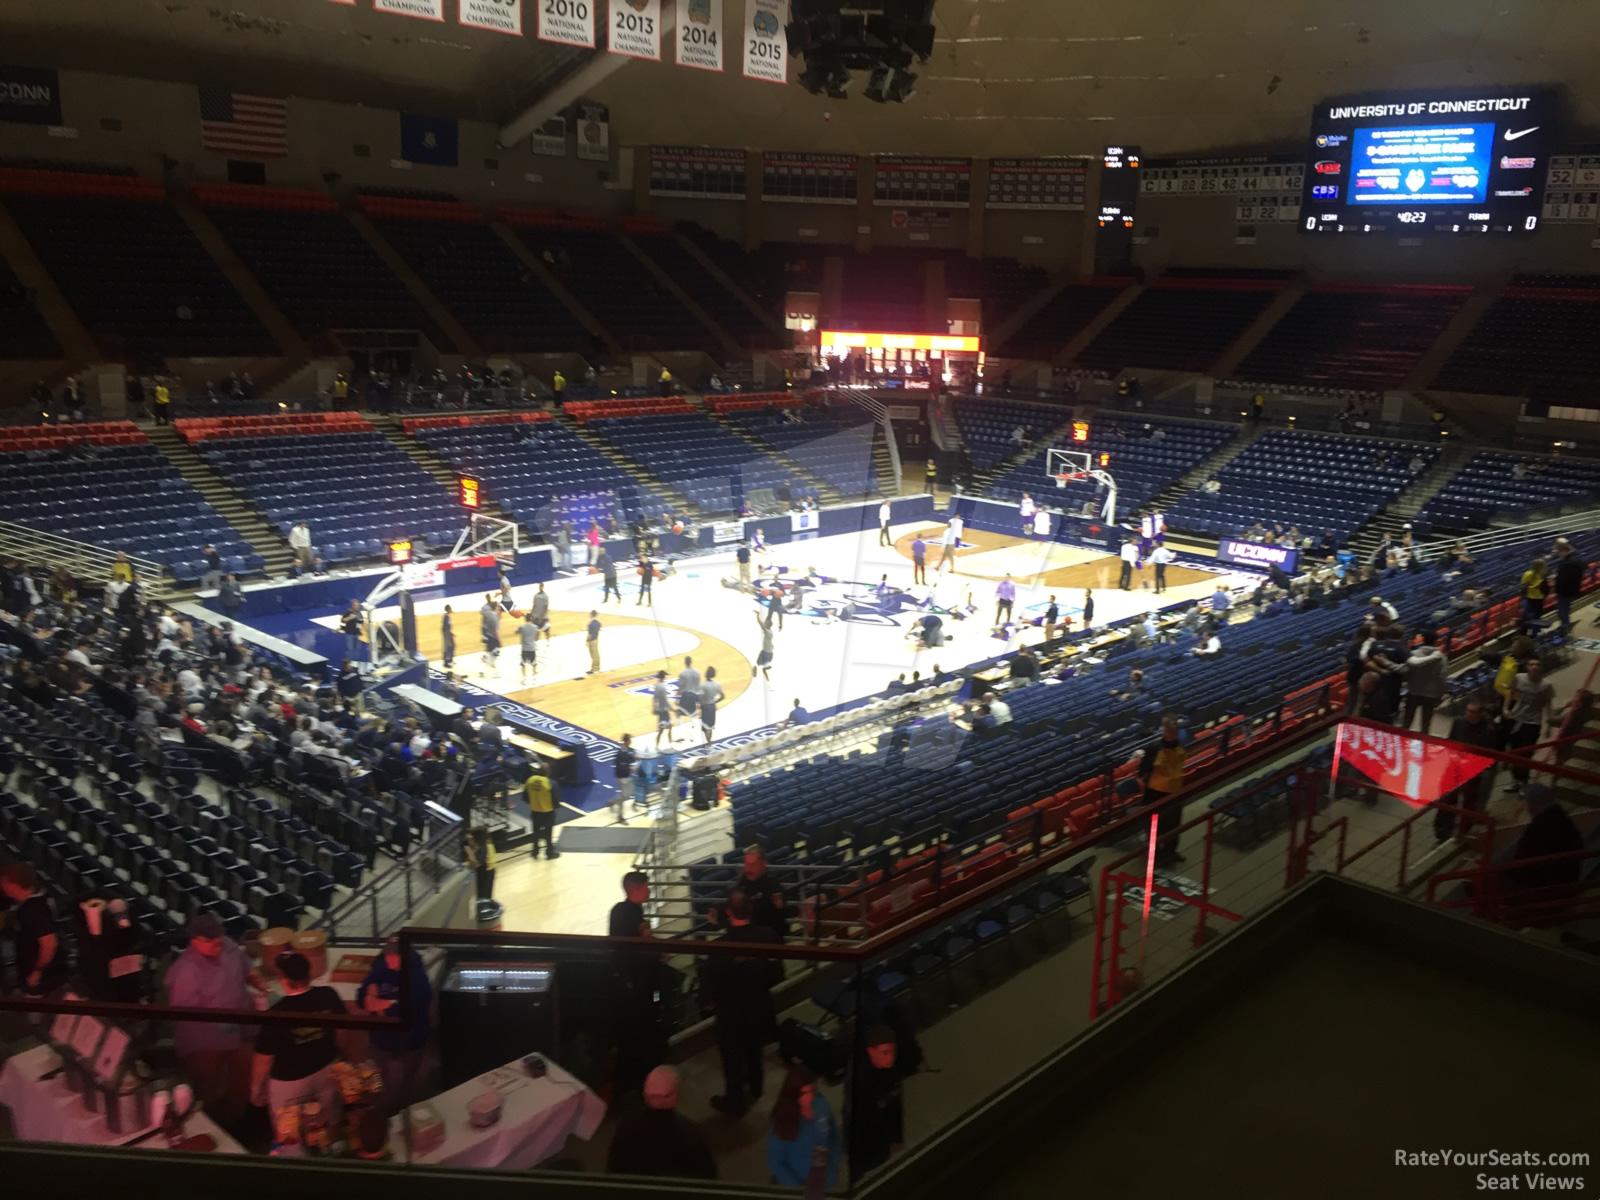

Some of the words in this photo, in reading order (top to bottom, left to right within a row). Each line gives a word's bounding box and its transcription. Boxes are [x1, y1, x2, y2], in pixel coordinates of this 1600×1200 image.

[382, 0, 435, 15] CHAMPIONS
[469, 2, 511, 18] NATIONAL
[545, 0, 587, 20] 2010
[466, 14, 515, 30] CHAMPIONS
[547, 17, 585, 32] NATIONAL
[616, 11, 653, 35] 2013
[544, 28, 589, 43] CHAMPIONS
[617, 32, 652, 46] NATIONAL
[682, 25, 717, 47] 2014
[614, 42, 655, 57] CHAMPIONS
[683, 45, 716, 58] NATIONAL
[749, 39, 781, 60] 2015
[681, 55, 718, 67] CHAMPIONS
[750, 58, 780, 70] NATIONAL
[747, 67, 782, 80] CHAMPIONS
[1329, 103, 1405, 119] UNIVERSITY
[1407, 102, 1426, 115] OF
[1428, 98, 1531, 114] CONNECTICUT
[1222, 178, 1236, 189] 42
[1242, 178, 1257, 189] 44
[1286, 176, 1301, 188] 42
[1552, 171, 1570, 183] 52
[1182, 180, 1196, 191] 22
[1313, 185, 1336, 195] CBS
[1261, 207, 1275, 218] 22
[1306, 216, 1316, 231] 0
[1525, 216, 1537, 231] 0
